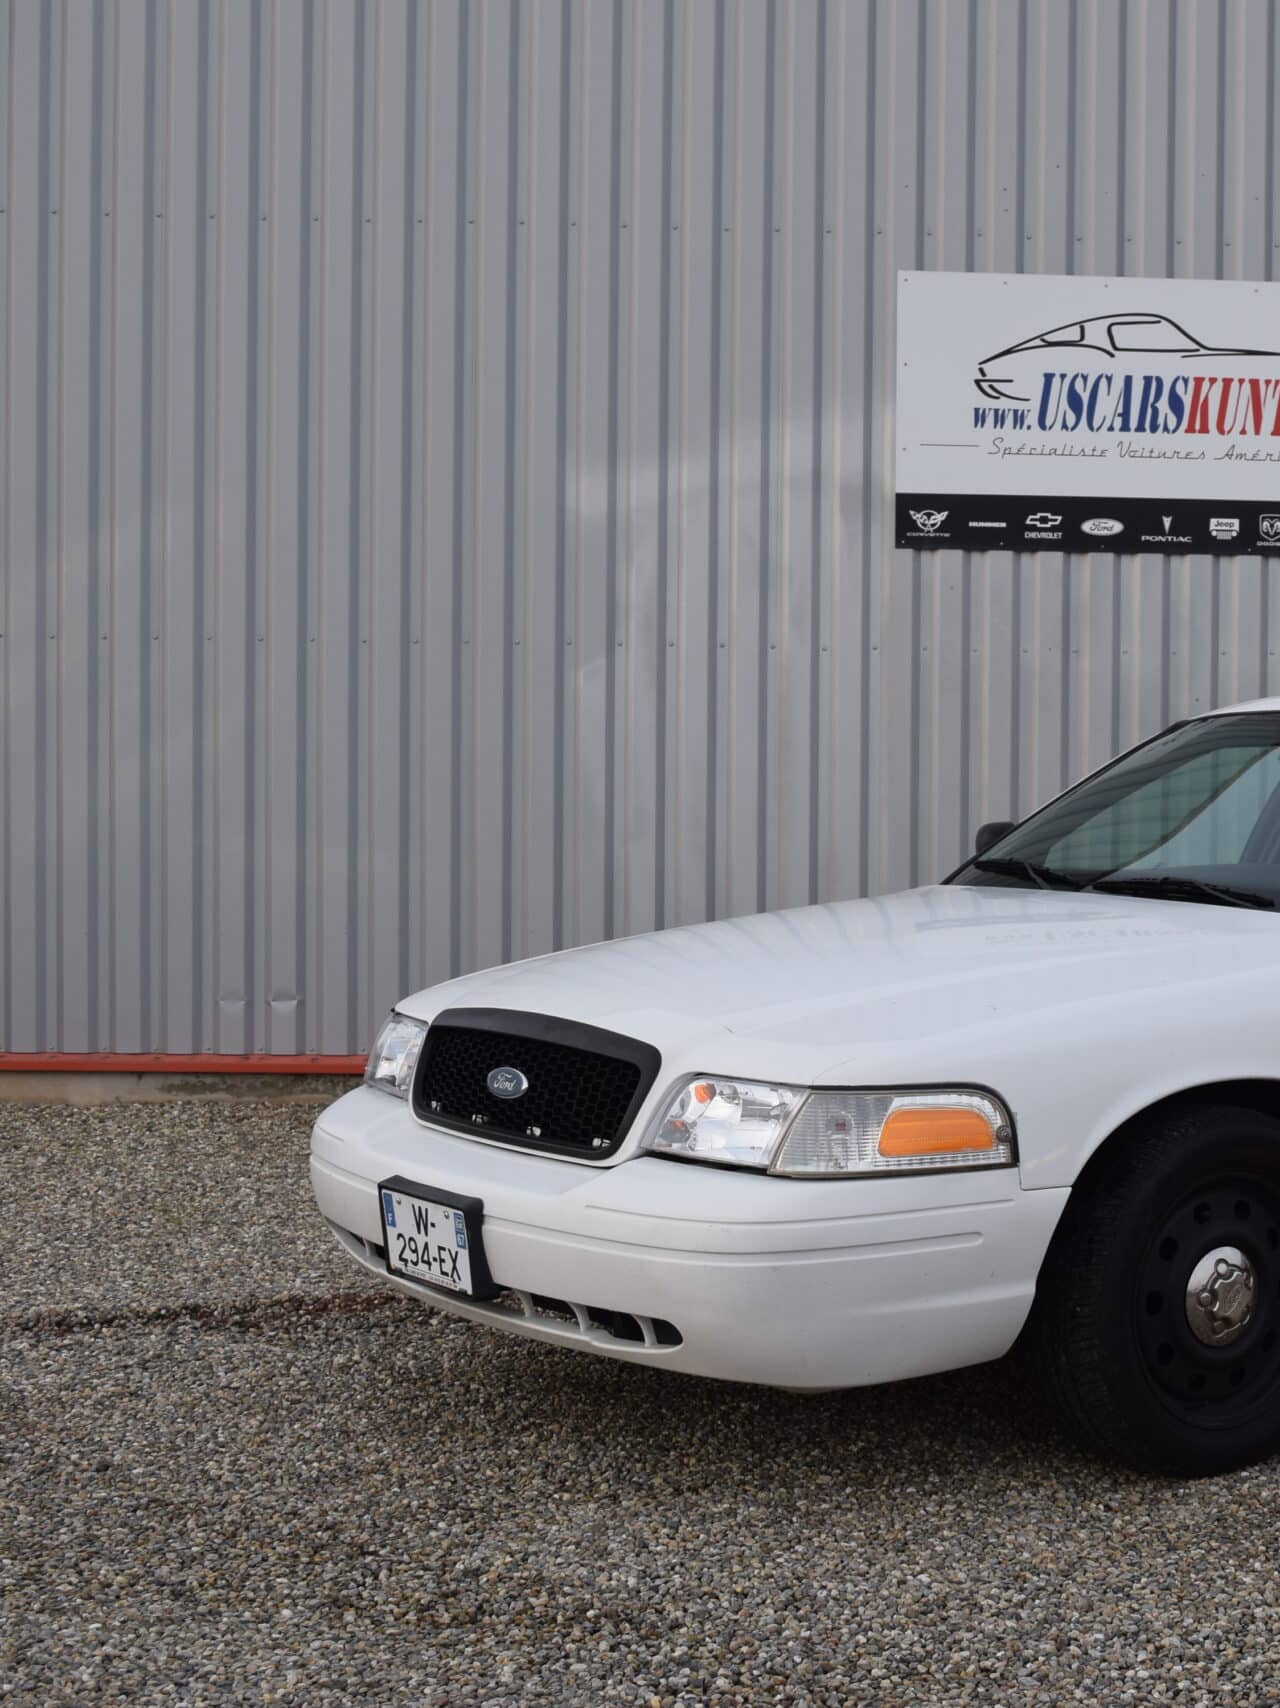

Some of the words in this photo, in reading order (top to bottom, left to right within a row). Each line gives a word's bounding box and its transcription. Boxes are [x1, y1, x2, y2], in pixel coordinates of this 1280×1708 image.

[987, 437, 1109, 459] Spécialiste
[1117, 441, 1206, 461] Voitures
[1089, 520, 1116, 533] Ford
[1214, 519, 1235, 529] Jeep
[1024, 531, 1063, 539] CHEVROLET
[1141, 535, 1193, 543] PONTIAC
[494, 1072, 517, 1090] Ford
[396, 1232, 461, 1283] 294-EX
